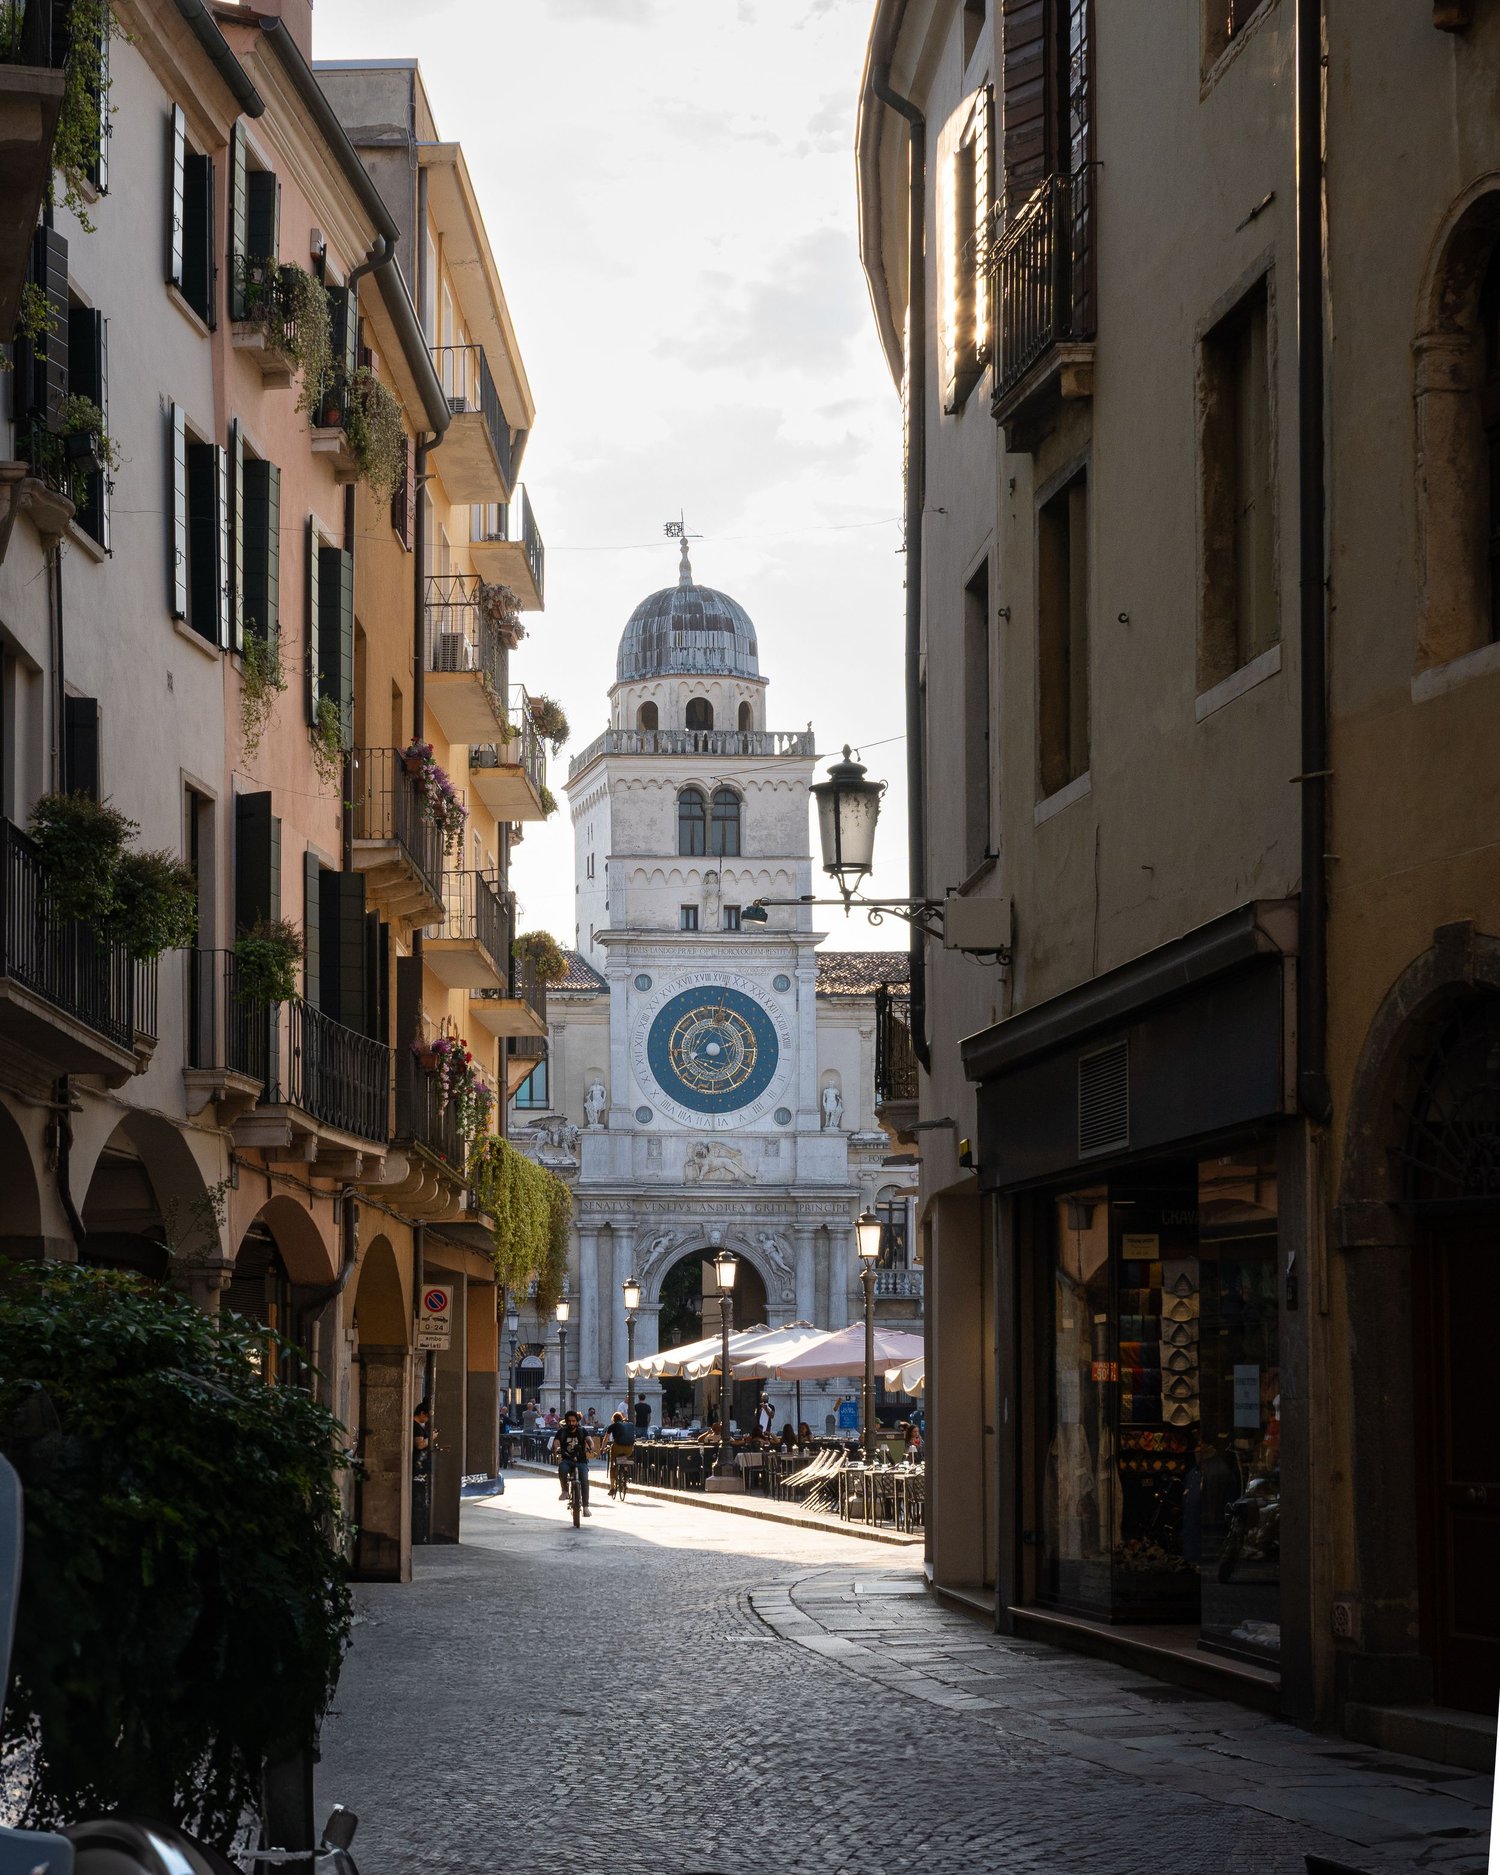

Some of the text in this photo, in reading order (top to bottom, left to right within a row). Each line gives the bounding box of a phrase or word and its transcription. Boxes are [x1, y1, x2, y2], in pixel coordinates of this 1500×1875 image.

[583, 1201, 632, 1210] SENATVS
[699, 1202, 746, 1212] ANDREA
[798, 1202, 849, 1212] PRINCIPE
